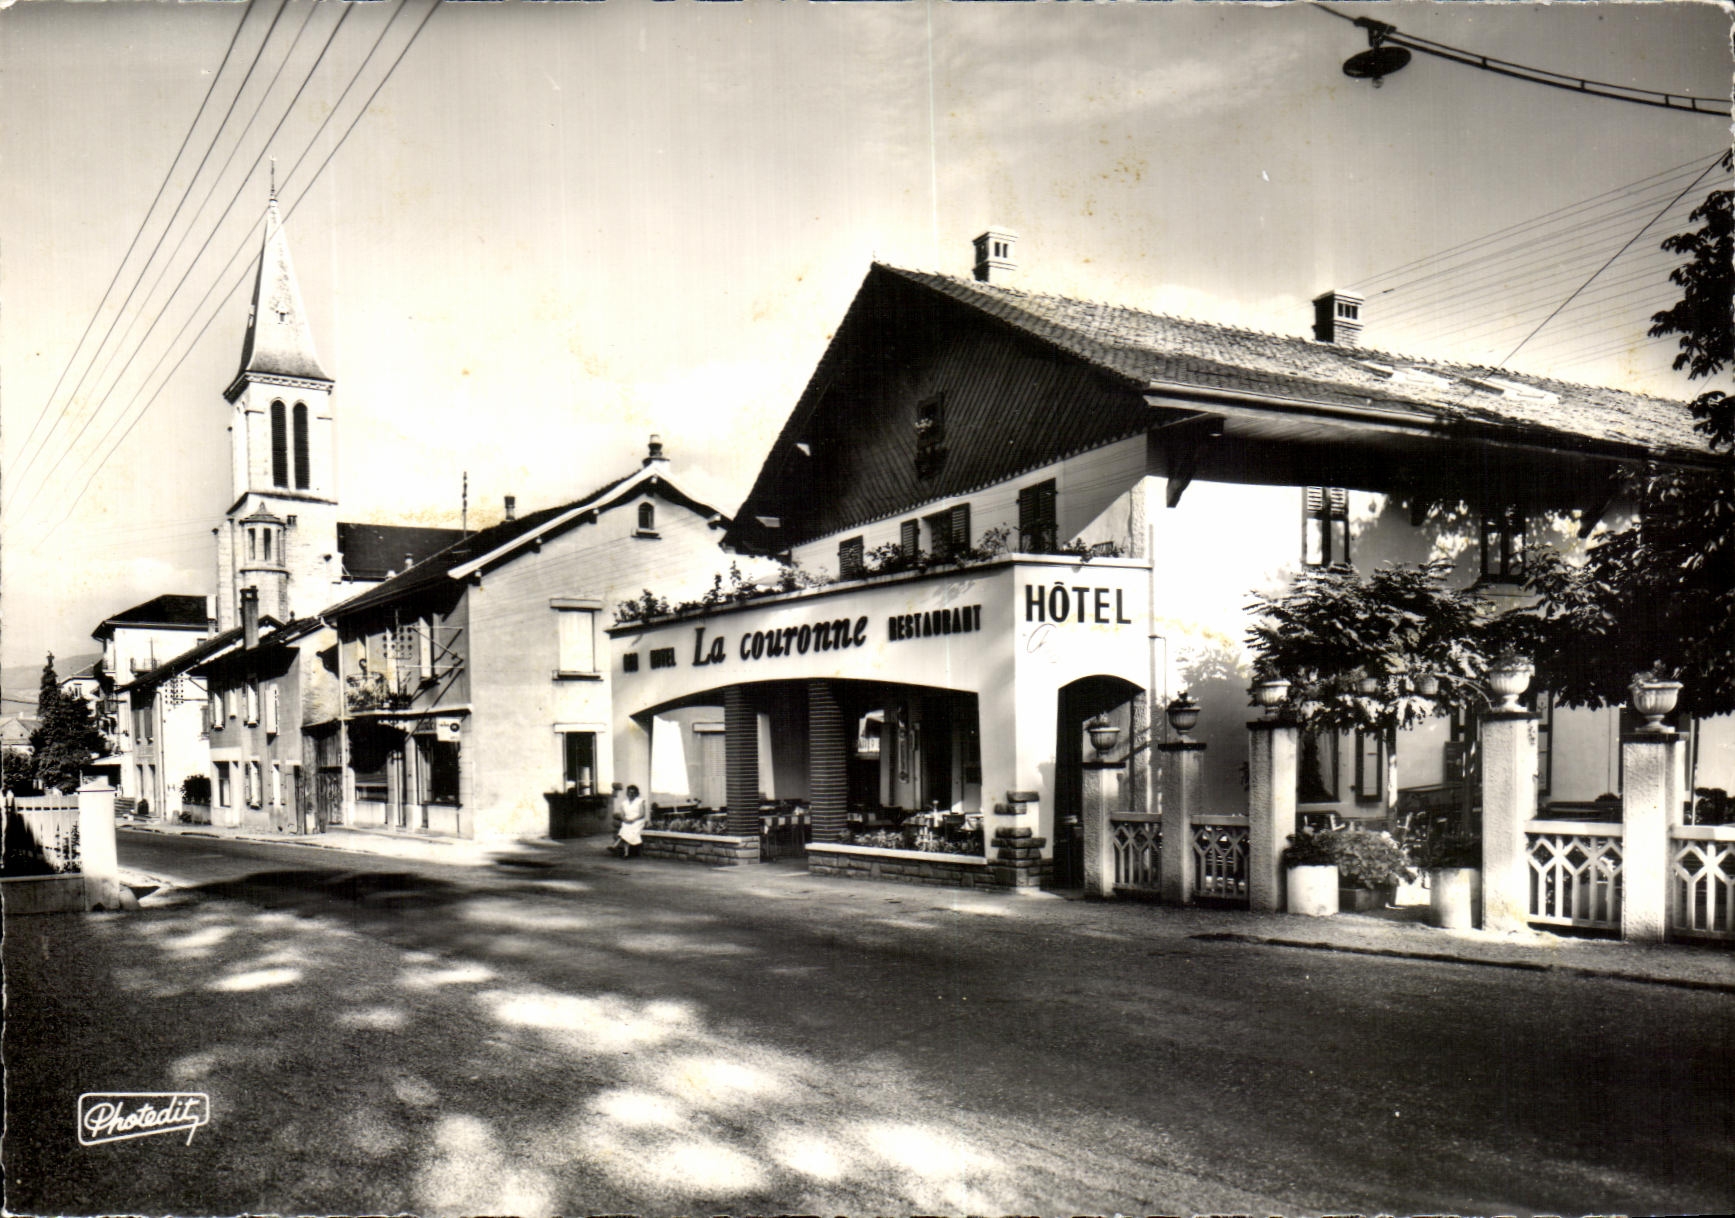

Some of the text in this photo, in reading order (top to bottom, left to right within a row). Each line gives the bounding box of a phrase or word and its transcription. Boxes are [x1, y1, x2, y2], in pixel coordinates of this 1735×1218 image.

[1025, 581, 1132, 624] HÔTEL
[692, 627, 726, 667] La
[740, 615, 868, 661] couronne
[888, 604, 981, 642] RESTAURANT
